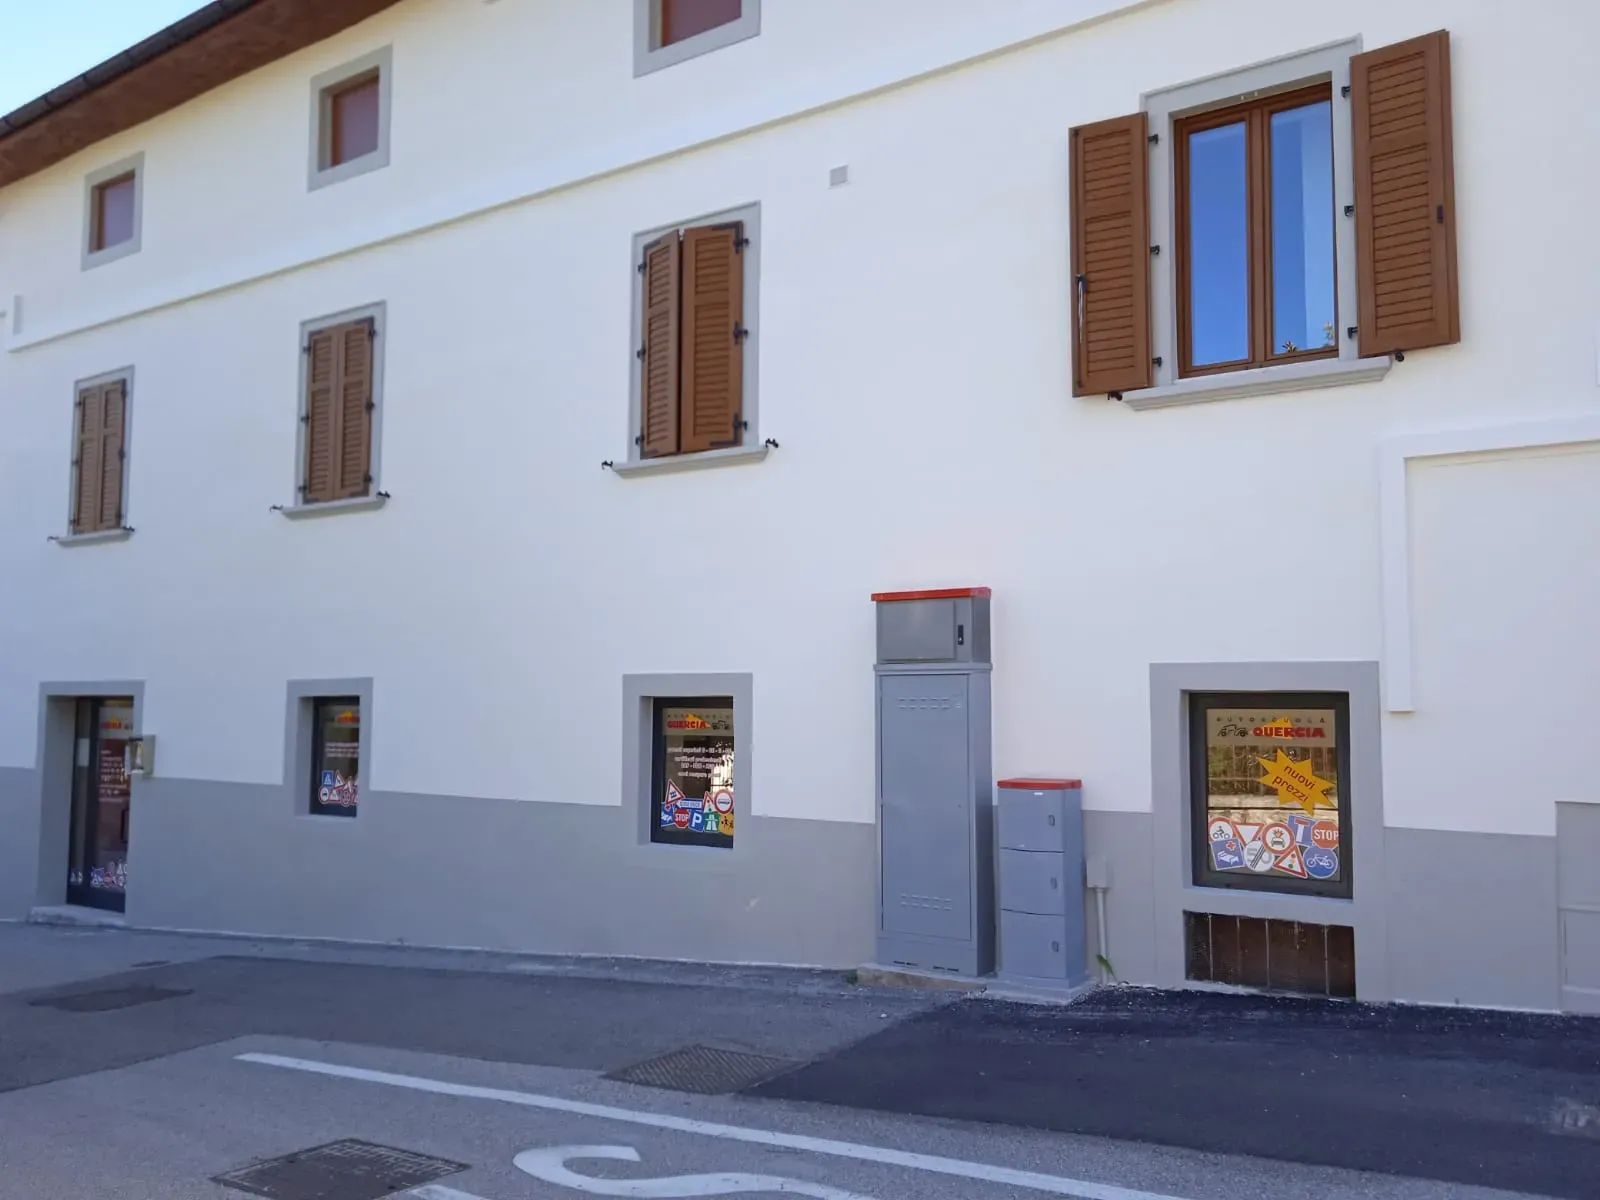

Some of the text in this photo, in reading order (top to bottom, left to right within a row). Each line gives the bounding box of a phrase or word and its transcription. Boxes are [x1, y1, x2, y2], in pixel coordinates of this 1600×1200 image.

[1252, 726, 1326, 738] QUERCIA
[1283, 765, 1317, 789] nuovi
[1272, 775, 1310, 803] prezzi
[675, 813, 689, 822] STOP
[1313, 830, 1339, 841] STOP
